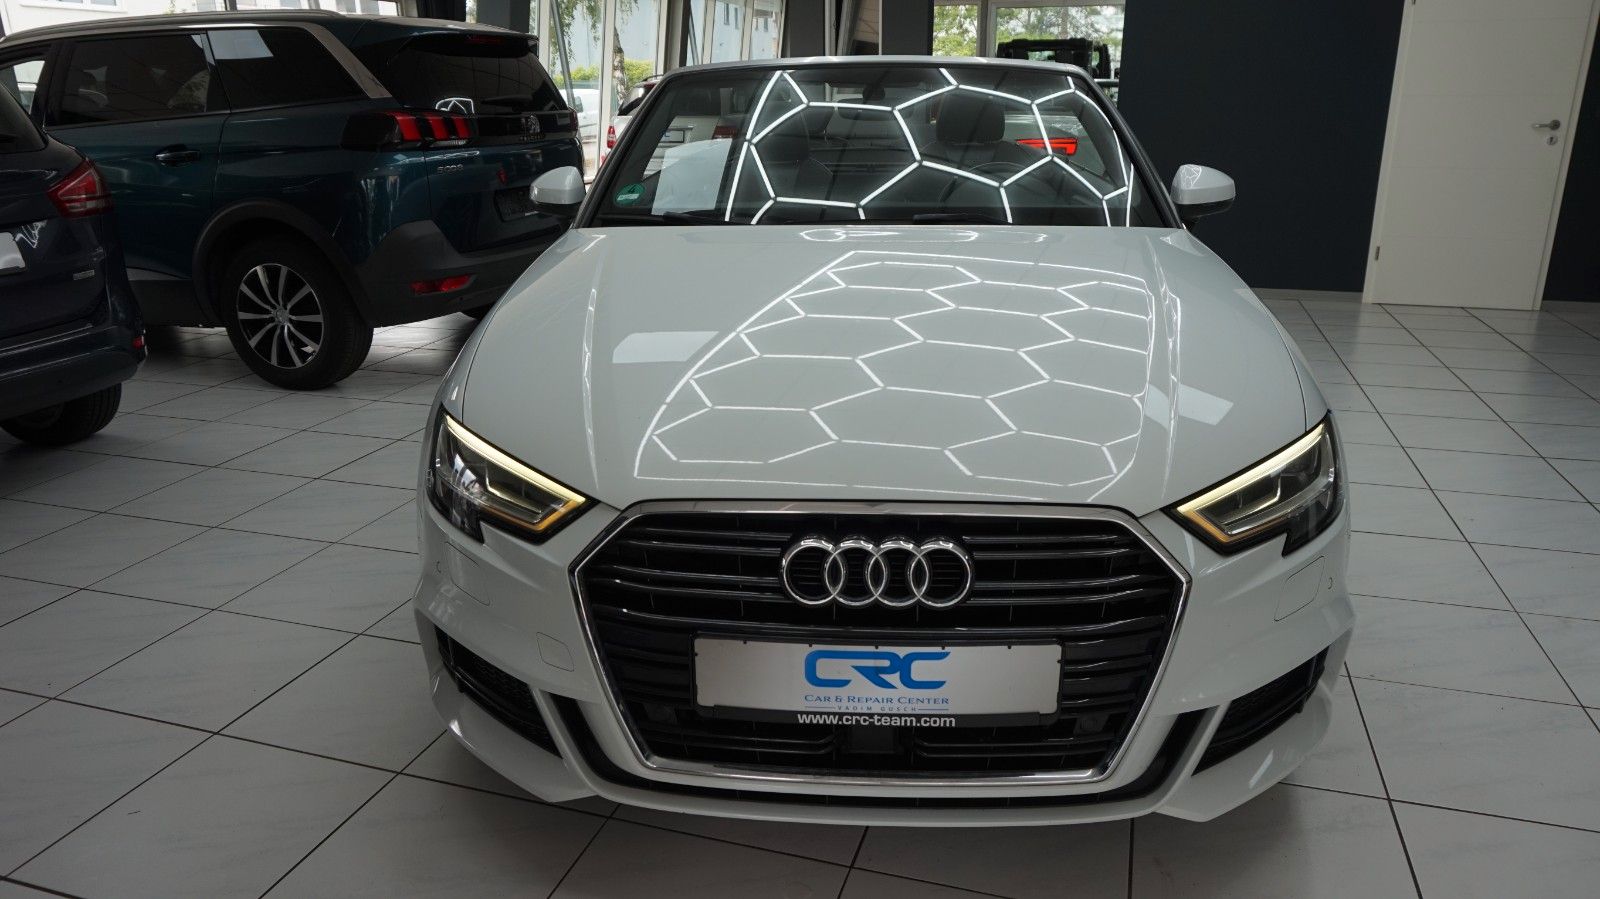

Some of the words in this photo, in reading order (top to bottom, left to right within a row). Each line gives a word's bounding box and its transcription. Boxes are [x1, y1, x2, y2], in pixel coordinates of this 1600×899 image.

[805, 649, 951, 689] CRC
[835, 695, 845, 703] &
[797, 713, 956, 727] www.crc-team.com
